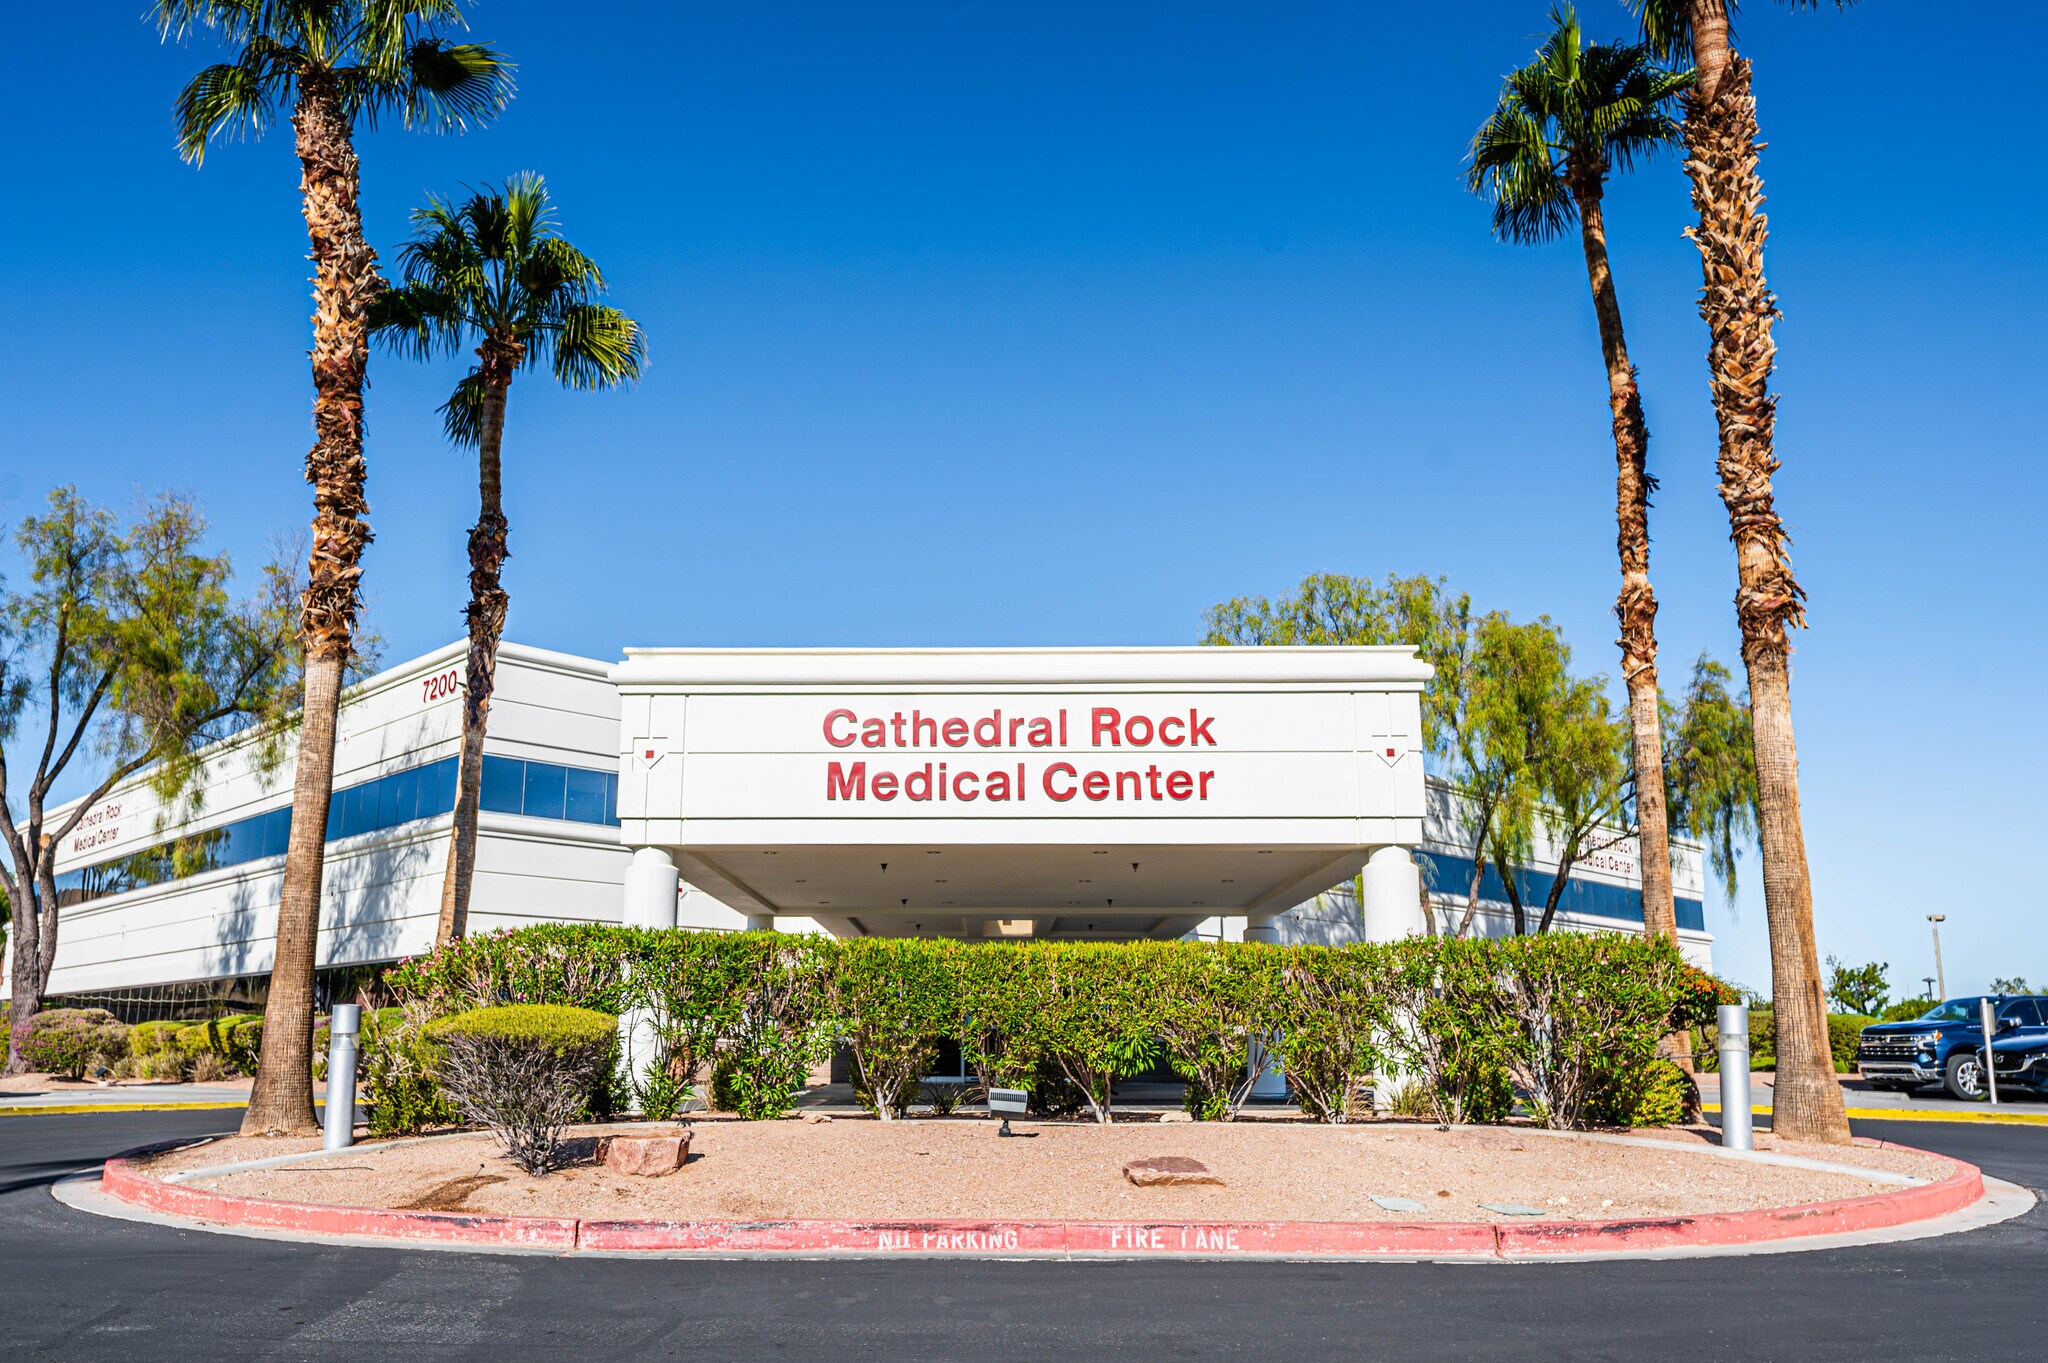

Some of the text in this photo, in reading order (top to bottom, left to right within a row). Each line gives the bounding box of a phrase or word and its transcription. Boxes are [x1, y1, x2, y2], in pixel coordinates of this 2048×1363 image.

[423, 670, 457, 703] 7200
[823, 707, 1217, 748] Cathedral Rock
[826, 761, 1215, 802] Medical Center
[106, 802, 122, 821] Rock
[74, 827, 119, 852] Medical Center
[1608, 856, 1634, 874] Center
[922, 1229, 1018, 1250] PARKING
[1111, 1226, 1165, 1249] FIRE
